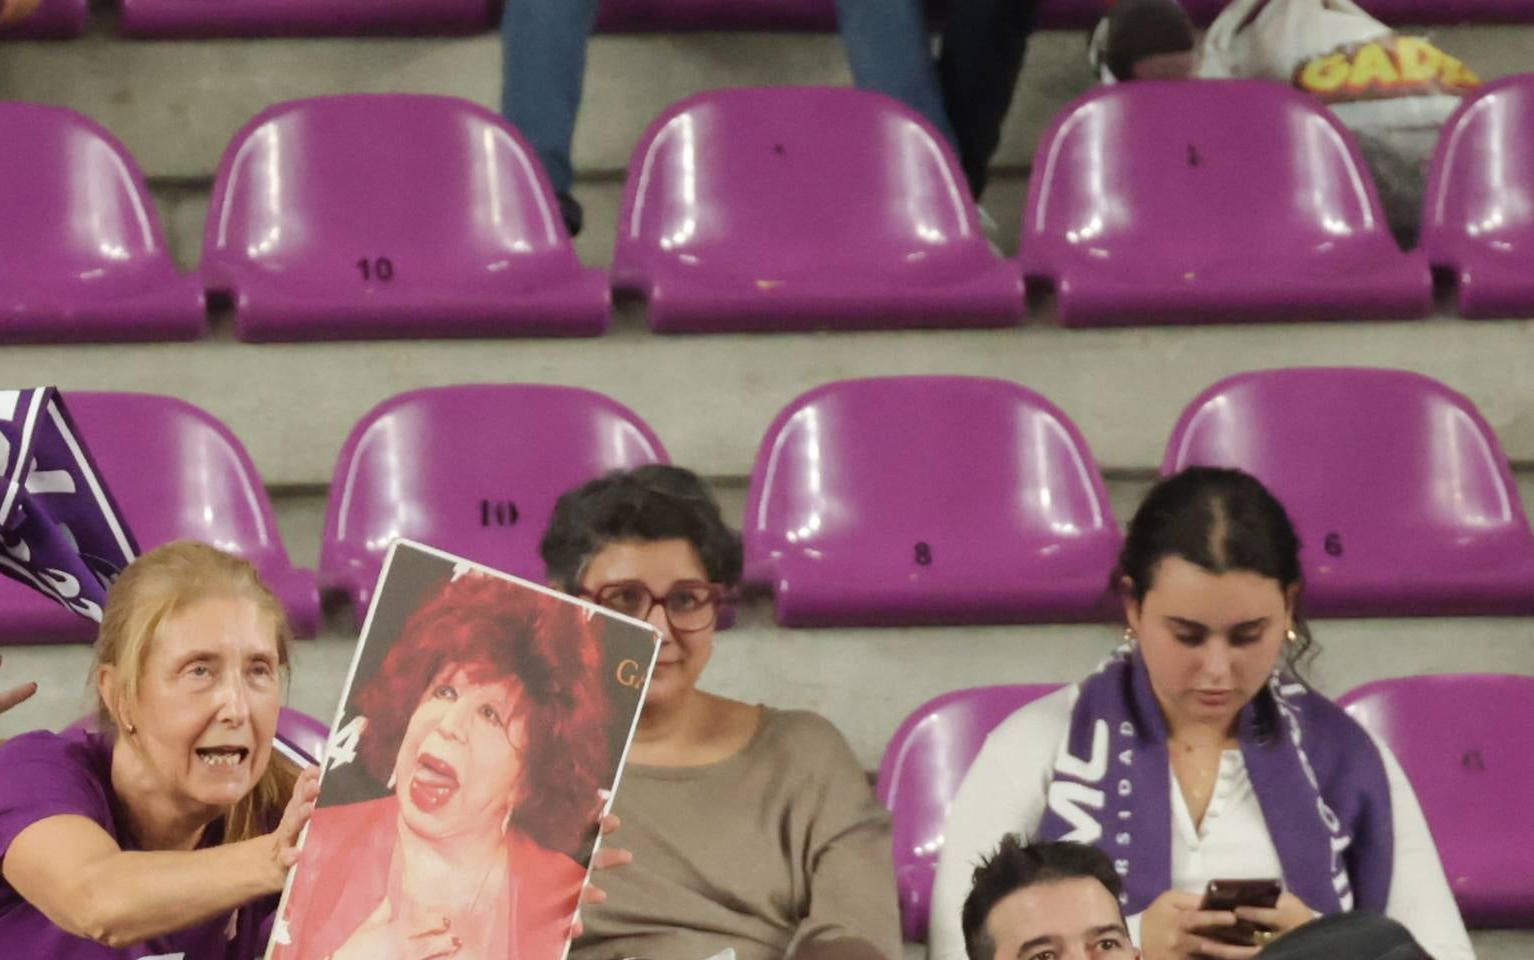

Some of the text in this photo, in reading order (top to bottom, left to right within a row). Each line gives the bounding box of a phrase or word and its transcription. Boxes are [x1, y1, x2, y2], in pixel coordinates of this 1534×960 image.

[356, 256, 393, 281] 10
[481, 499, 519, 527] 10
[914, 541, 932, 566] 8
[1324, 532, 1342, 557] 6
